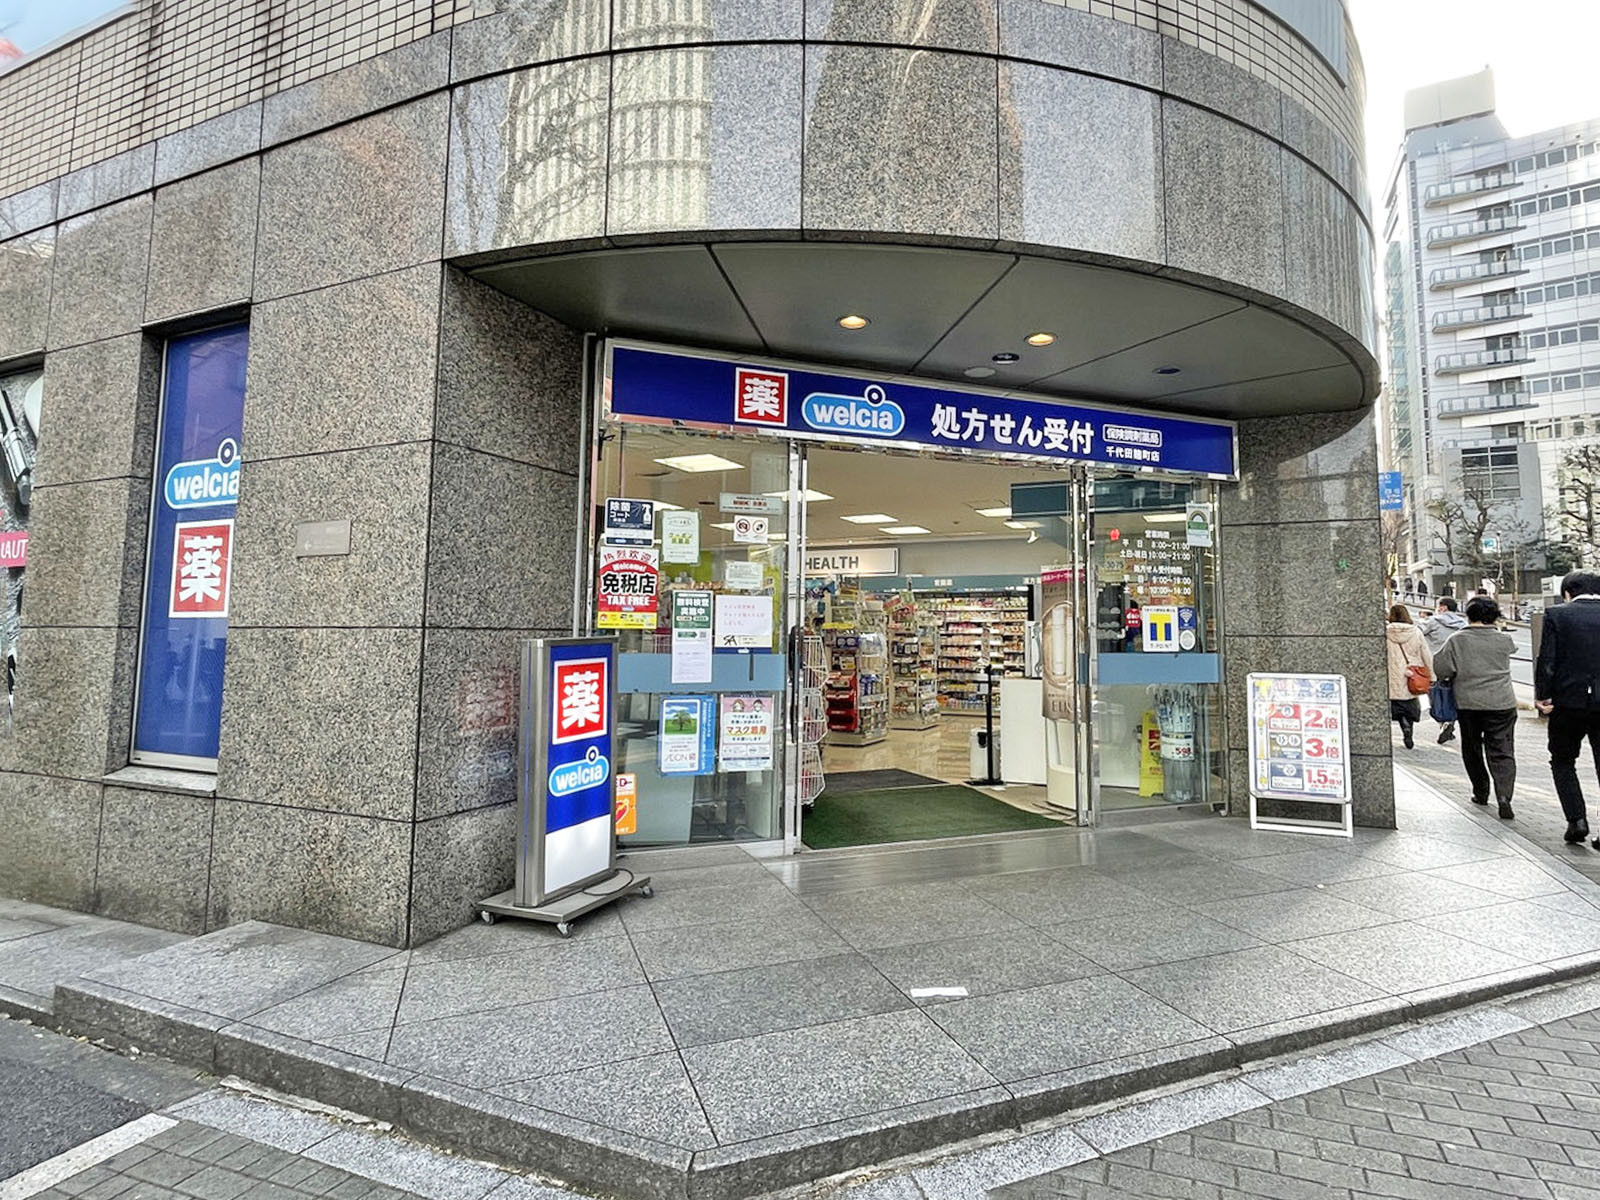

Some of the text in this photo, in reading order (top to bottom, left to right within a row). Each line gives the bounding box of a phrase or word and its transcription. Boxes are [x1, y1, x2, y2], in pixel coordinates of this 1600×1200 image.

[742, 377, 780, 418] 薬
[812, 401, 894, 430] welcia
[931, 403, 1095, 455] 処方せん受付
[173, 464, 240, 501] welcia
[179, 535, 223, 603] 薬
[805, 555, 859, 570] HEALTH
[602, 572, 656, 594] 免税店
[606, 595, 650, 607] TAX FREE
[561, 670, 600, 728] 薬
[726, 726, 767, 735] マスク着用
[555, 764, 603, 791] welcia
